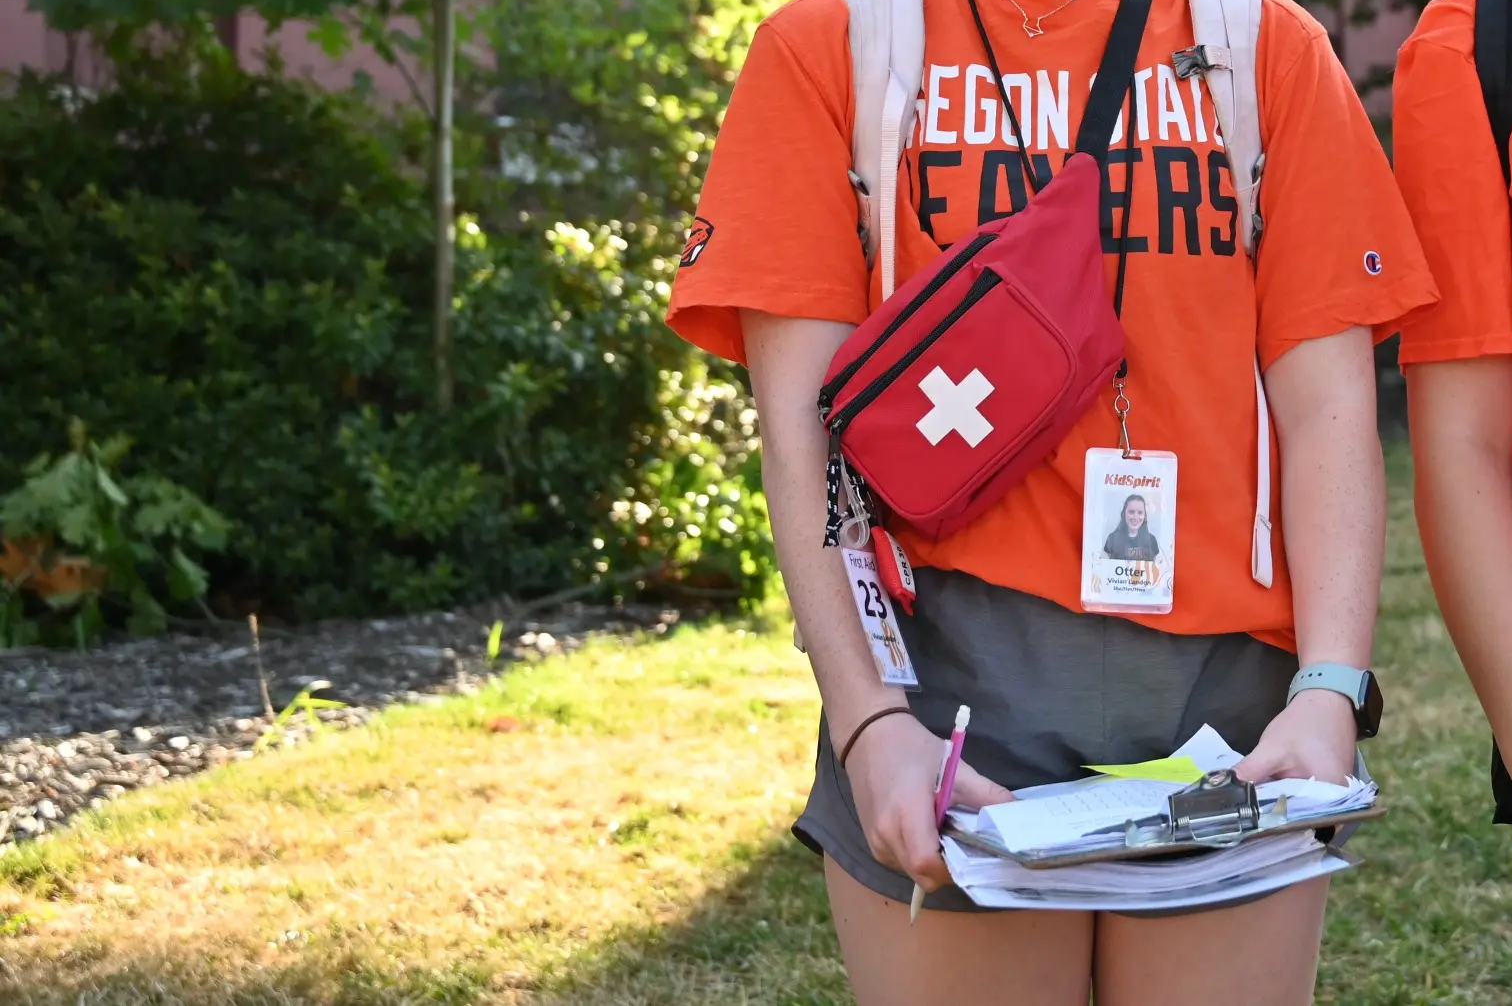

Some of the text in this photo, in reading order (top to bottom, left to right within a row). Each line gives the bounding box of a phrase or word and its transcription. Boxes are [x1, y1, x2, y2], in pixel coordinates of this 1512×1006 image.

[907, 63, 1070, 150] EGON
[905, 146, 1238, 257] EAERS
[1104, 473, 1161, 489] KidSpirit
[848, 553, 863, 569] First
[902, 561, 911, 586] CPR
[1114, 565, 1145, 577] Otter
[857, 579, 888, 620] 23
